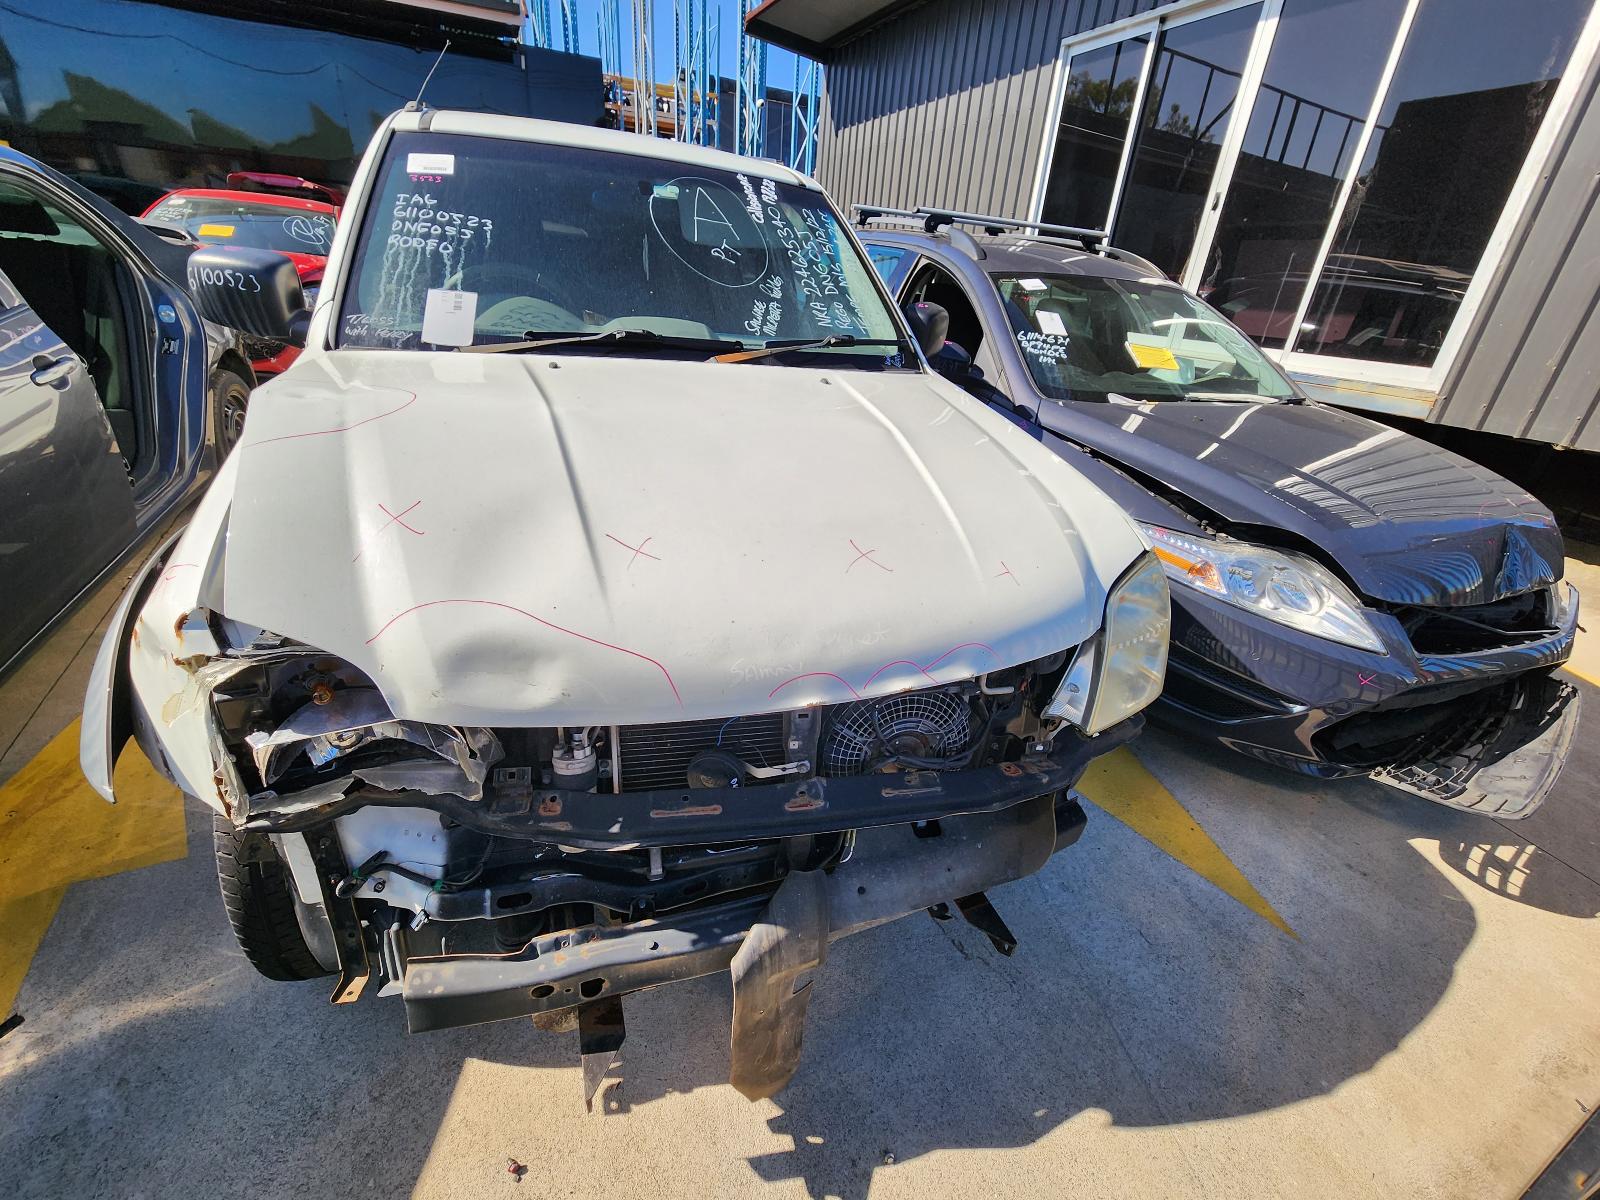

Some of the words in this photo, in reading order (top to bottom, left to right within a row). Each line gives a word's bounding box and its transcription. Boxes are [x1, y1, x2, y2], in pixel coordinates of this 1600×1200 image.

[395, 193, 438, 205] IAG
[393, 205, 493, 230] 61100523
[693, 186, 741, 242] A
